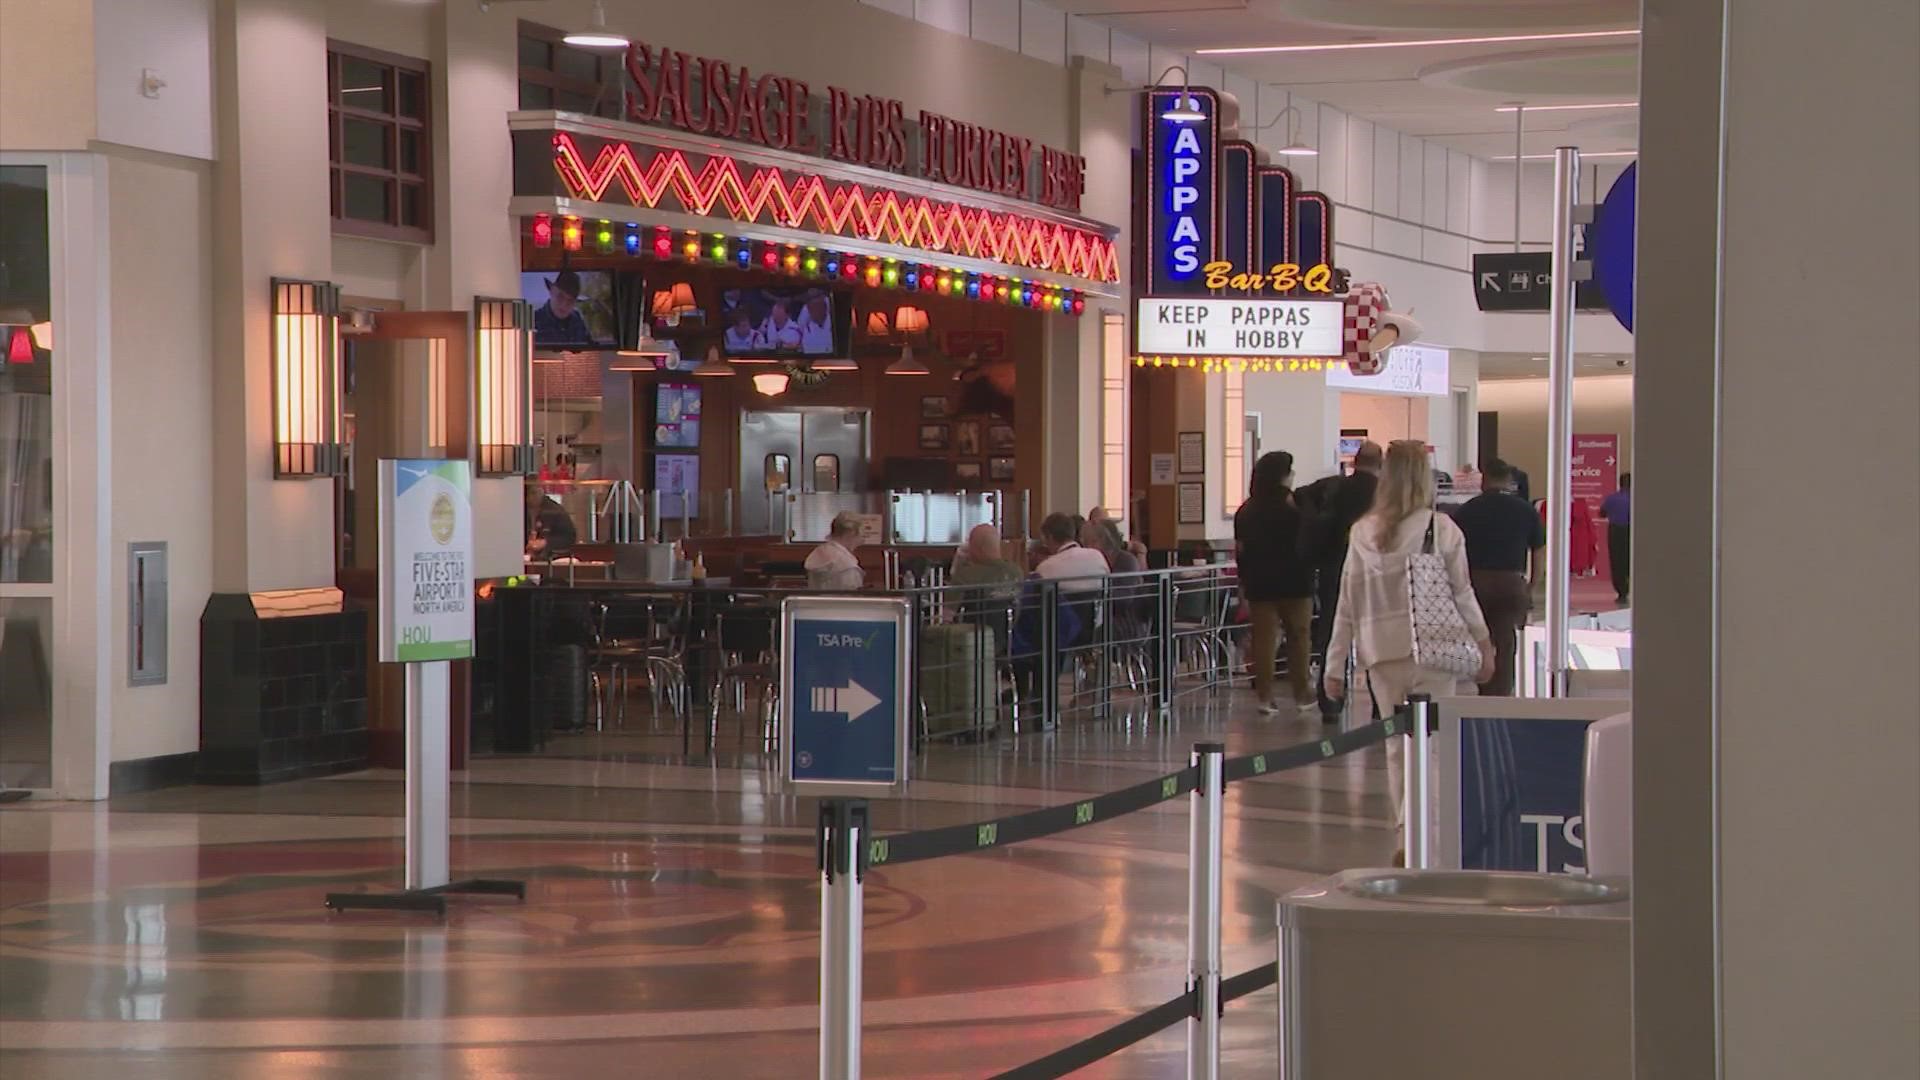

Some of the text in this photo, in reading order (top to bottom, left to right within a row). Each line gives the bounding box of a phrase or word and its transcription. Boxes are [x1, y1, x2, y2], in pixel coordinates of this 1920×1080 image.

[626, 41, 816, 149] SAUSAGE
[828, 86, 906, 168] RIBS
[920, 110, 1034, 198] TURKEY
[1158, 305, 1310, 326] KEEP PAPPAS
[1187, 329, 1304, 349] IN HOBBY
[1571, 454, 1585, 465] elf
[1571, 467, 1602, 477] ervice
[413, 561, 465, 582] FIVE-STAR
[414, 583, 456, 601] AIRPORT
[413, 601, 440, 615] NORTH
[403, 624, 431, 643] HOU
[817, 633, 863, 648] TSA Pre
[1077, 801, 1095, 825] HOU
[978, 822, 998, 847] HOU
[1520, 814, 1588, 875] TS
